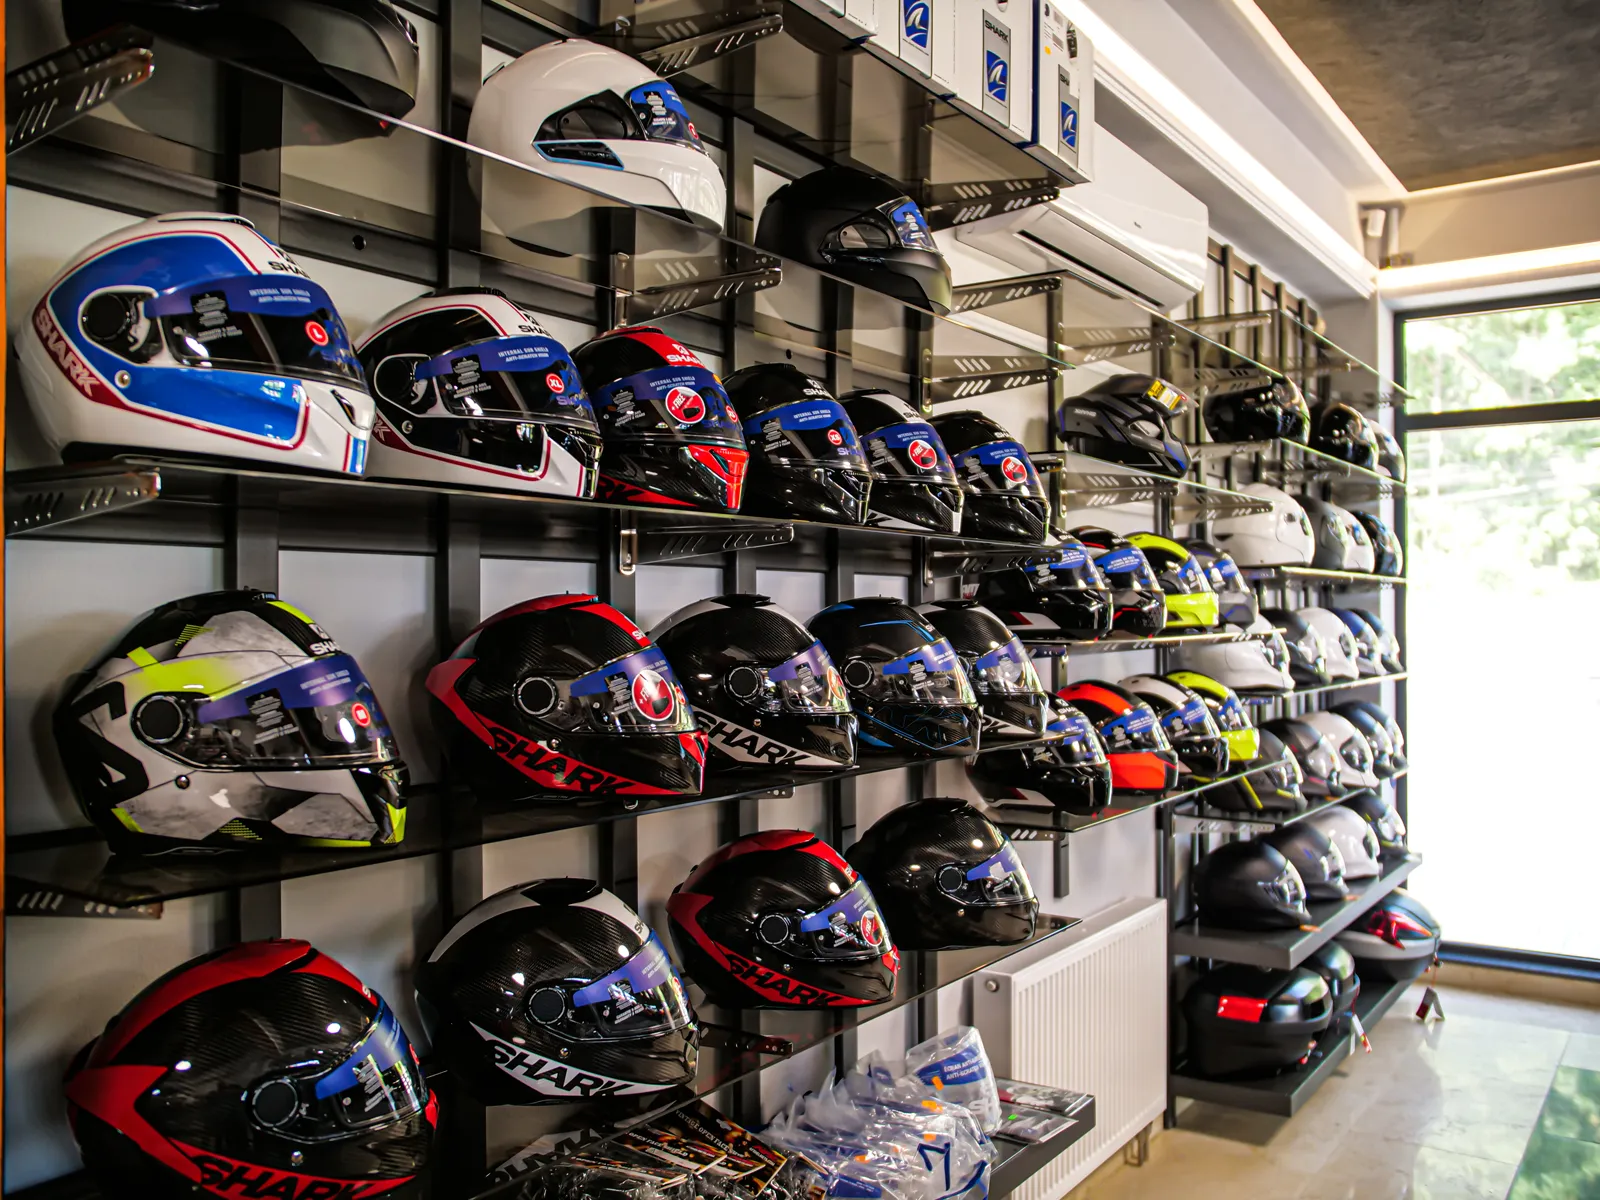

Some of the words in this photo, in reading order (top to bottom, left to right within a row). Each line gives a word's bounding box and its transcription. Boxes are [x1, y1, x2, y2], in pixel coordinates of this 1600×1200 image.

[985, 19, 1009, 43] SHARK
[35, 308, 101, 397] SHARK
[312, 327, 323, 339] L
[550, 378, 563, 388] XL
[673, 392, 686, 409] FREE
[489, 726, 639, 794] SHARK
[696, 711, 812, 766] SHARK
[725, 954, 844, 1006] SHARK
[491, 1041, 633, 1097] SHARK
[628, 1132, 648, 1144] OPEN
[675, 1110, 700, 1130] VINTAGE
[698, 1127, 718, 1144] OPEN
[713, 1138, 730, 1152] FACE
[193, 1155, 375, 1200] SHARK
